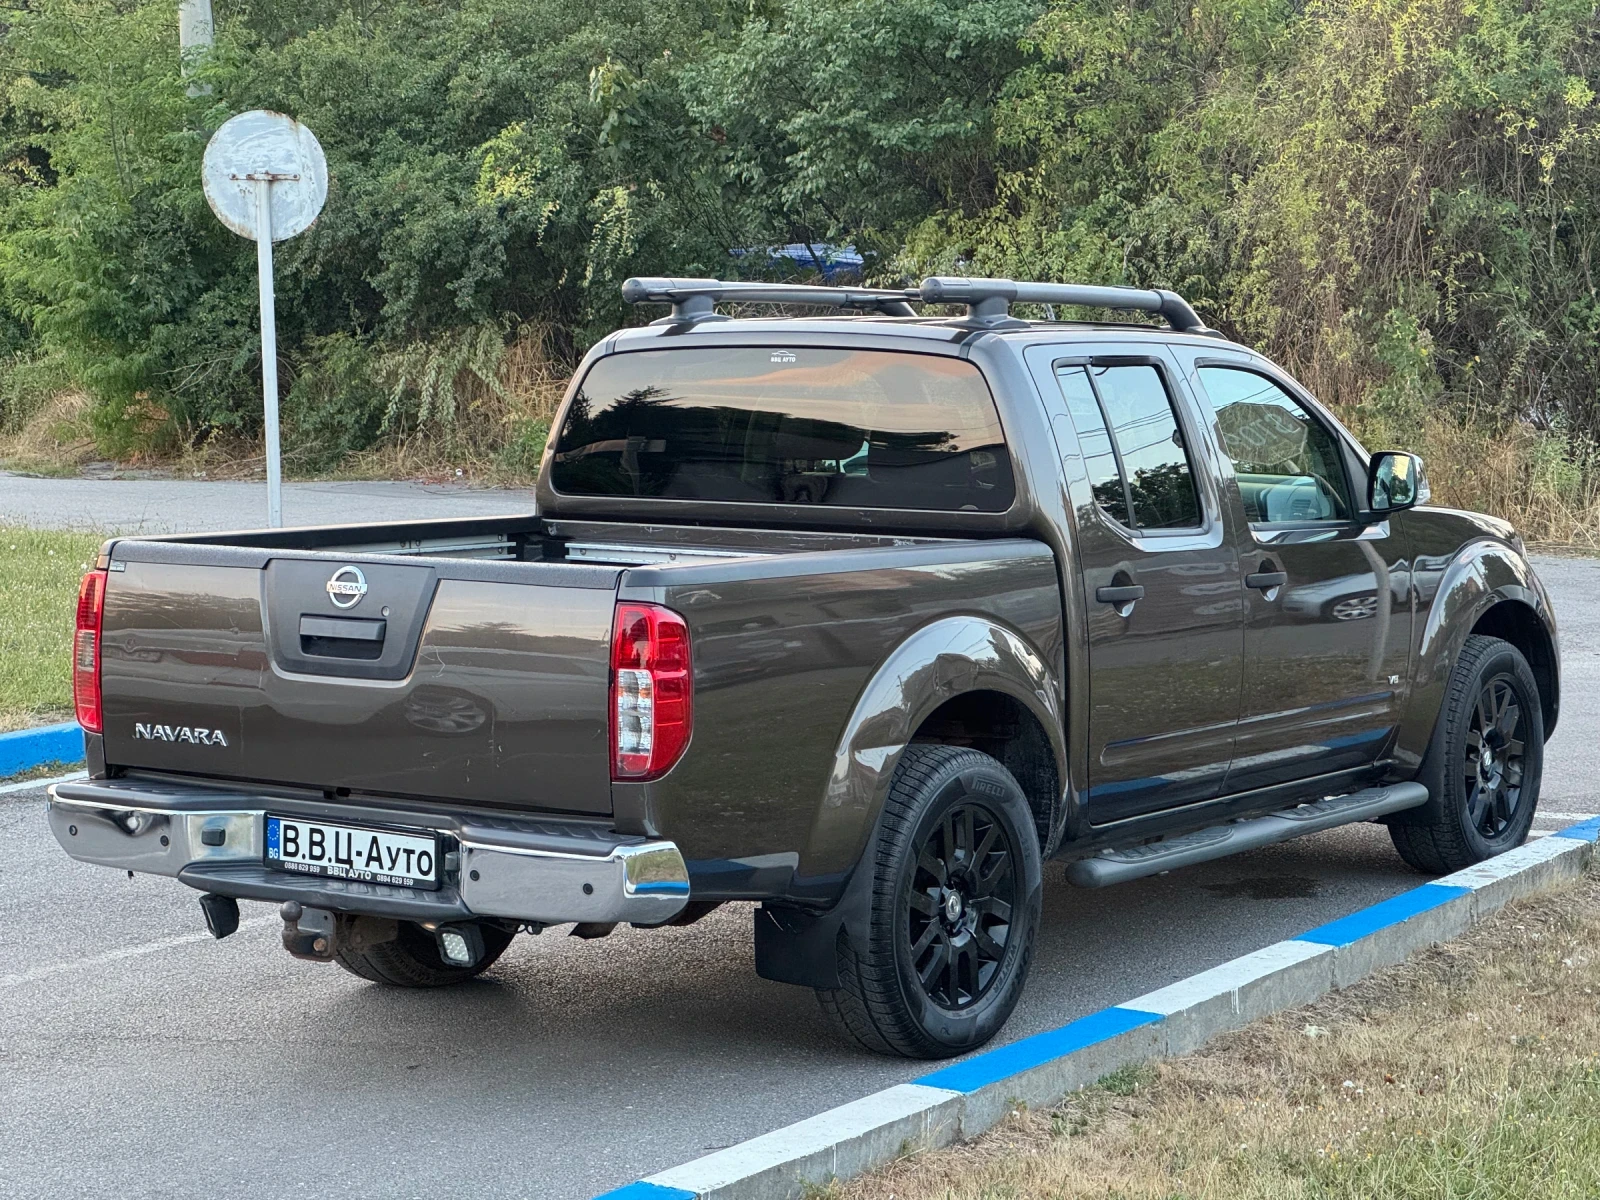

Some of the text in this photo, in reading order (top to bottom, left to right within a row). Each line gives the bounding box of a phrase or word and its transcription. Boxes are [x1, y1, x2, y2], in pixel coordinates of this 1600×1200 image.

[329, 583, 362, 592] NISSAN
[134, 722, 229, 747] NAVARA
[971, 774, 1006, 798] PIRELLI
[268, 847, 279, 859] BG
[282, 823, 434, 877] В.В.Ц-Ауто
[327, 865, 346, 878] ВВЦ
[347, 868, 372, 880] АУТО
